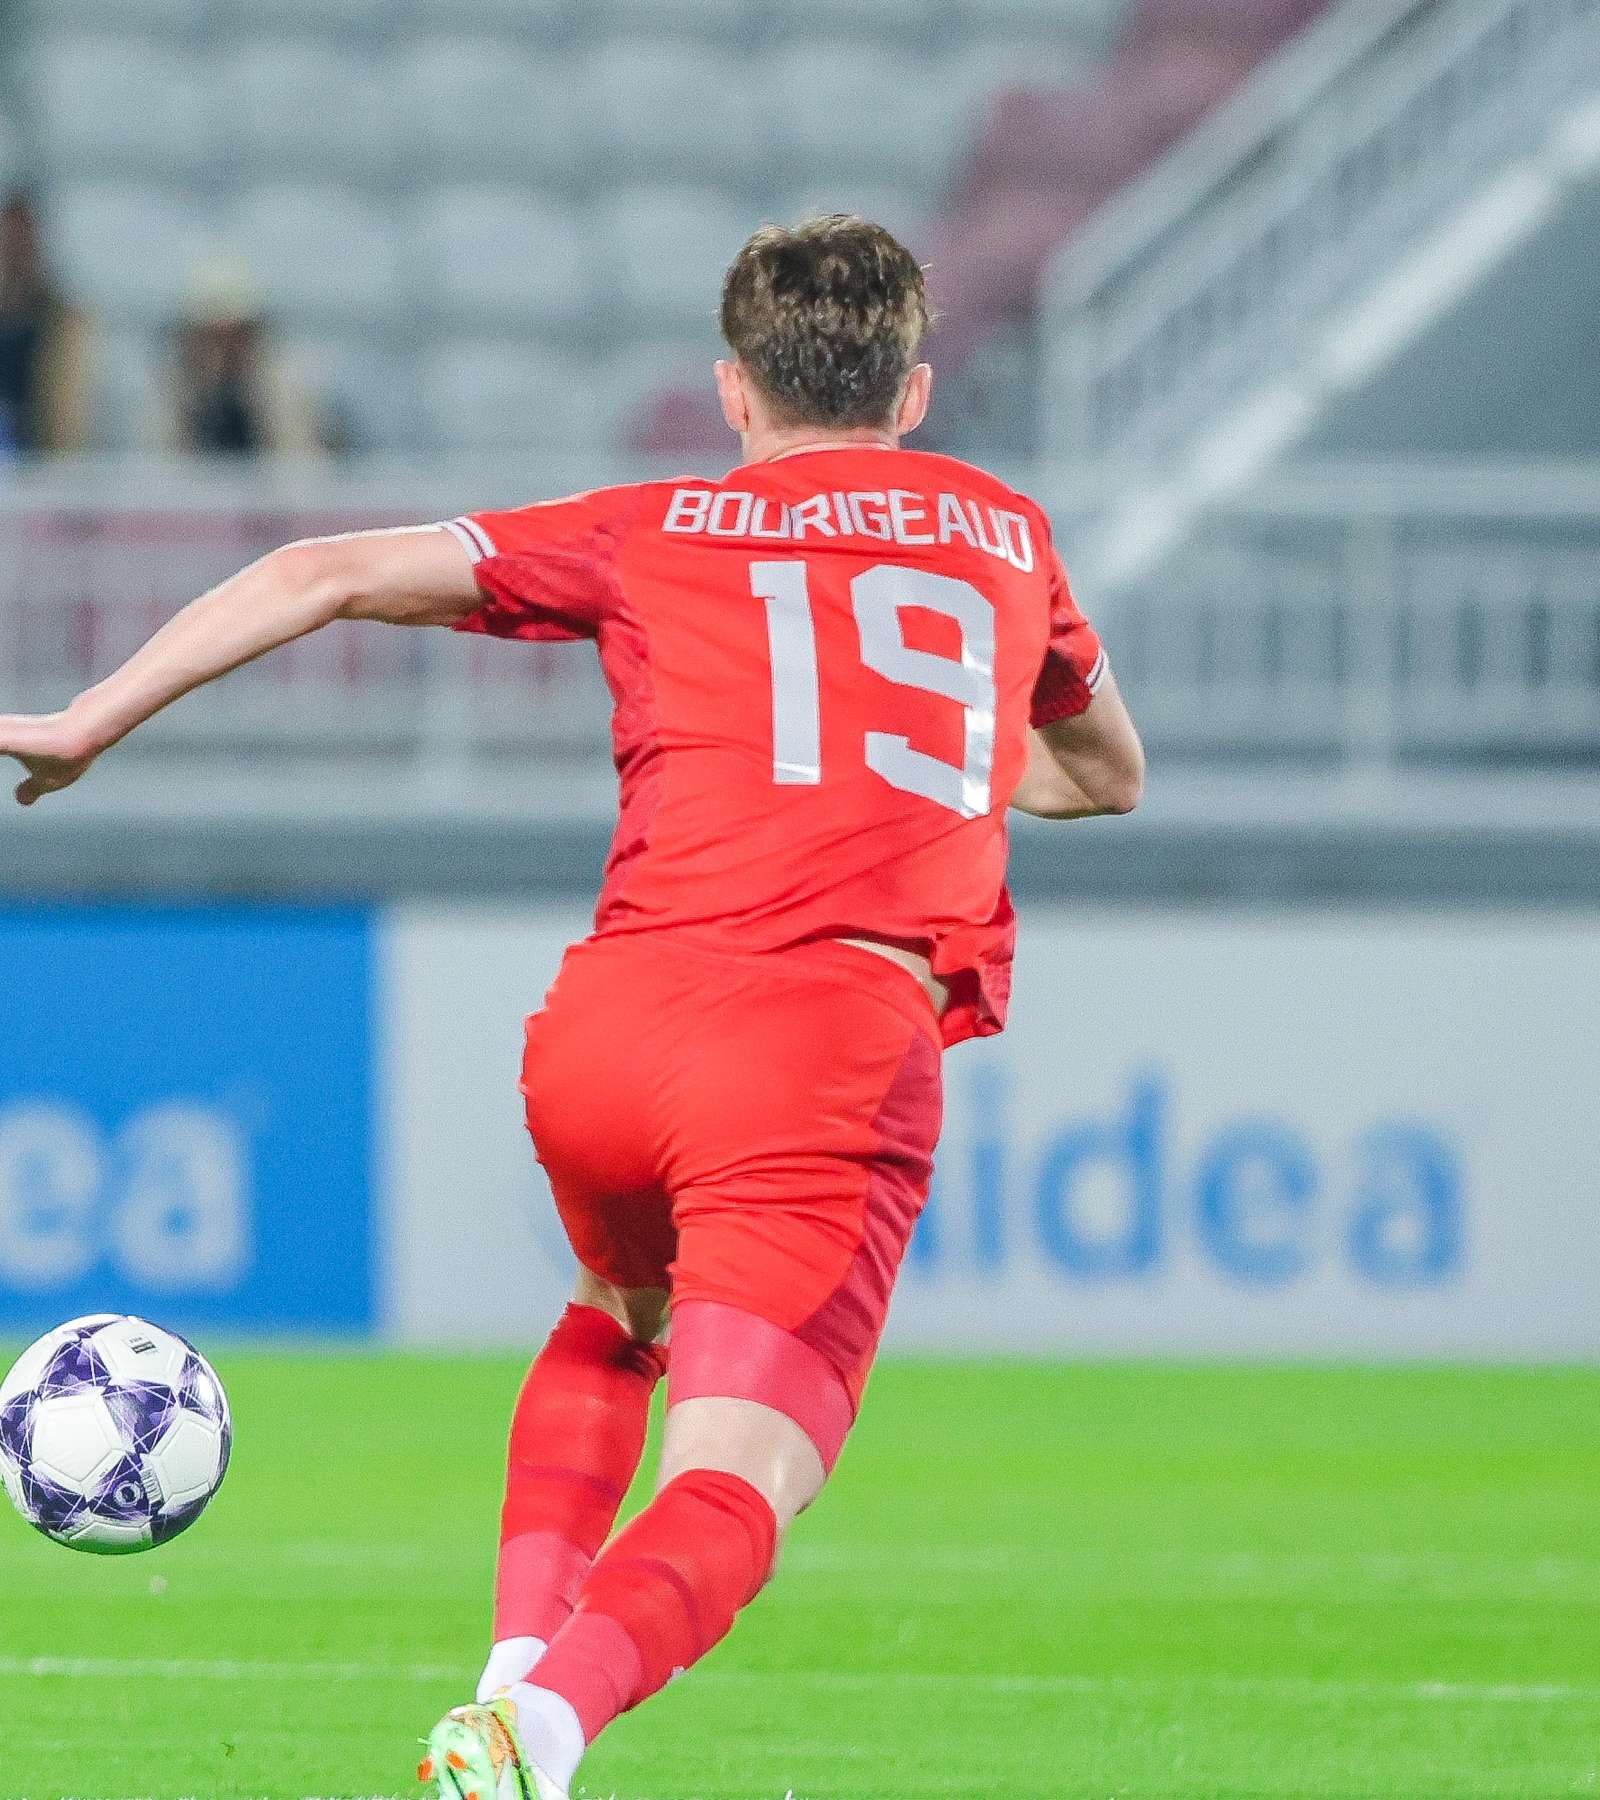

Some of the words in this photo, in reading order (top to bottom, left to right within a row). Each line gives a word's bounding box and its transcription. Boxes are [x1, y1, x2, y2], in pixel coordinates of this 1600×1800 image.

[662, 488, 1034, 573] BOURIGEAUD
[749, 560, 995, 820] 19
[906, 1056, 1468, 1290] idea
